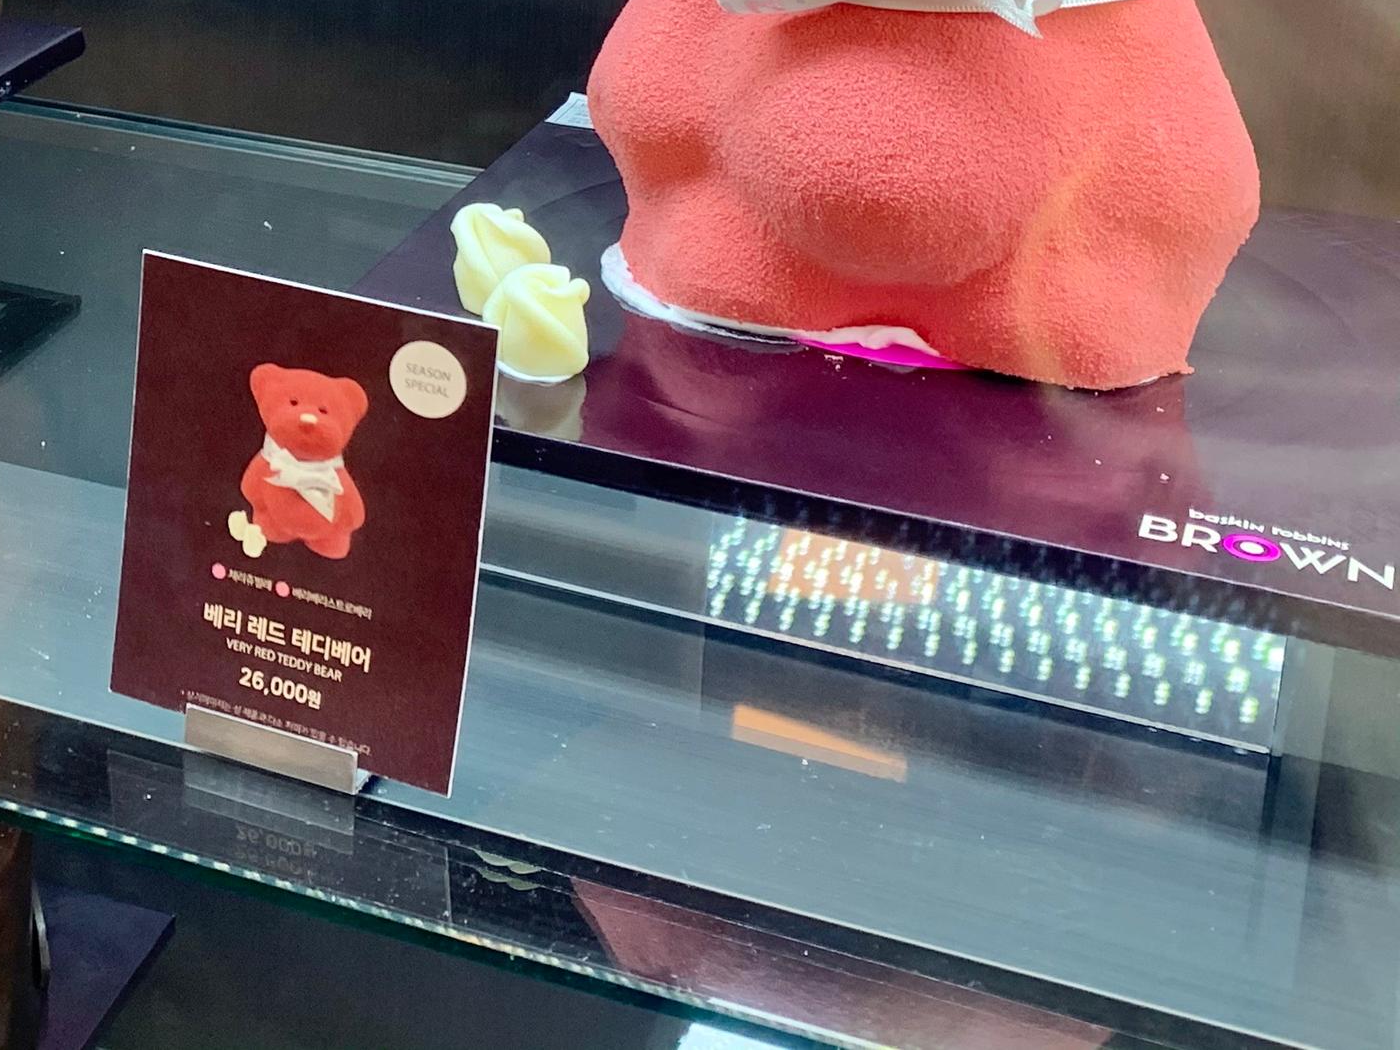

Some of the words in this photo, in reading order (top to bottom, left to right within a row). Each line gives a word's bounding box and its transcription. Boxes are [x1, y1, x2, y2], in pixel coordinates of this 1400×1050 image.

[404, 377, 450, 399] SPECIAL
[406, 362, 451, 382] SEASON
[1188, 508, 1264, 533] baskin
[1272, 526, 1350, 551] robbins
[1138, 514, 1395, 590] BROWN
[203, 602, 242, 635] 베리
[247, 614, 286, 646] 레드
[291, 627, 371, 673] 테디베어
[226, 637, 253, 655] VERY
[254, 645, 277, 662] RED
[277, 651, 313, 673] TEDDY
[314, 663, 343, 683] BEAR
[239, 666, 322, 710] 26,000원
